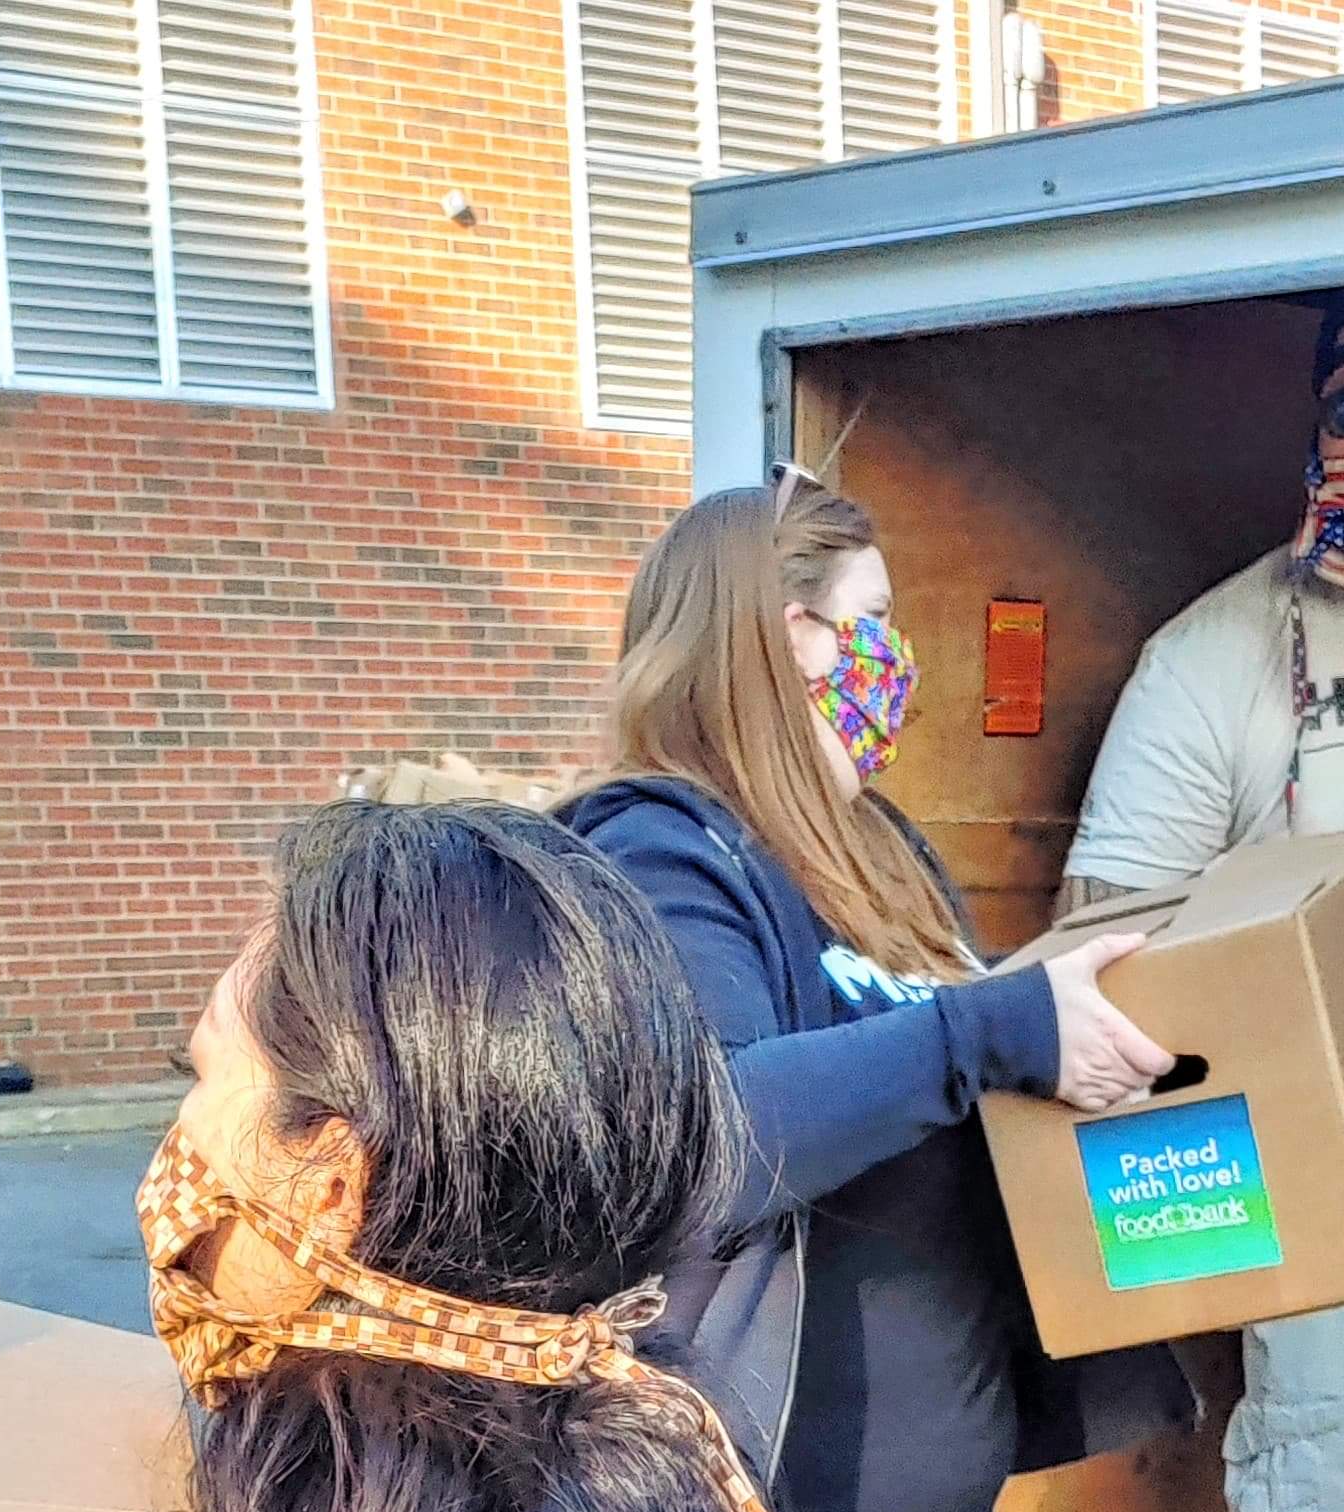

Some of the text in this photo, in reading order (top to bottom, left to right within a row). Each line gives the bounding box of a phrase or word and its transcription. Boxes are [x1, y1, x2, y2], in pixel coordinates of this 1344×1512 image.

[1119, 1136, 1219, 1179] Packed
[1109, 1160, 1242, 1204] with love!
